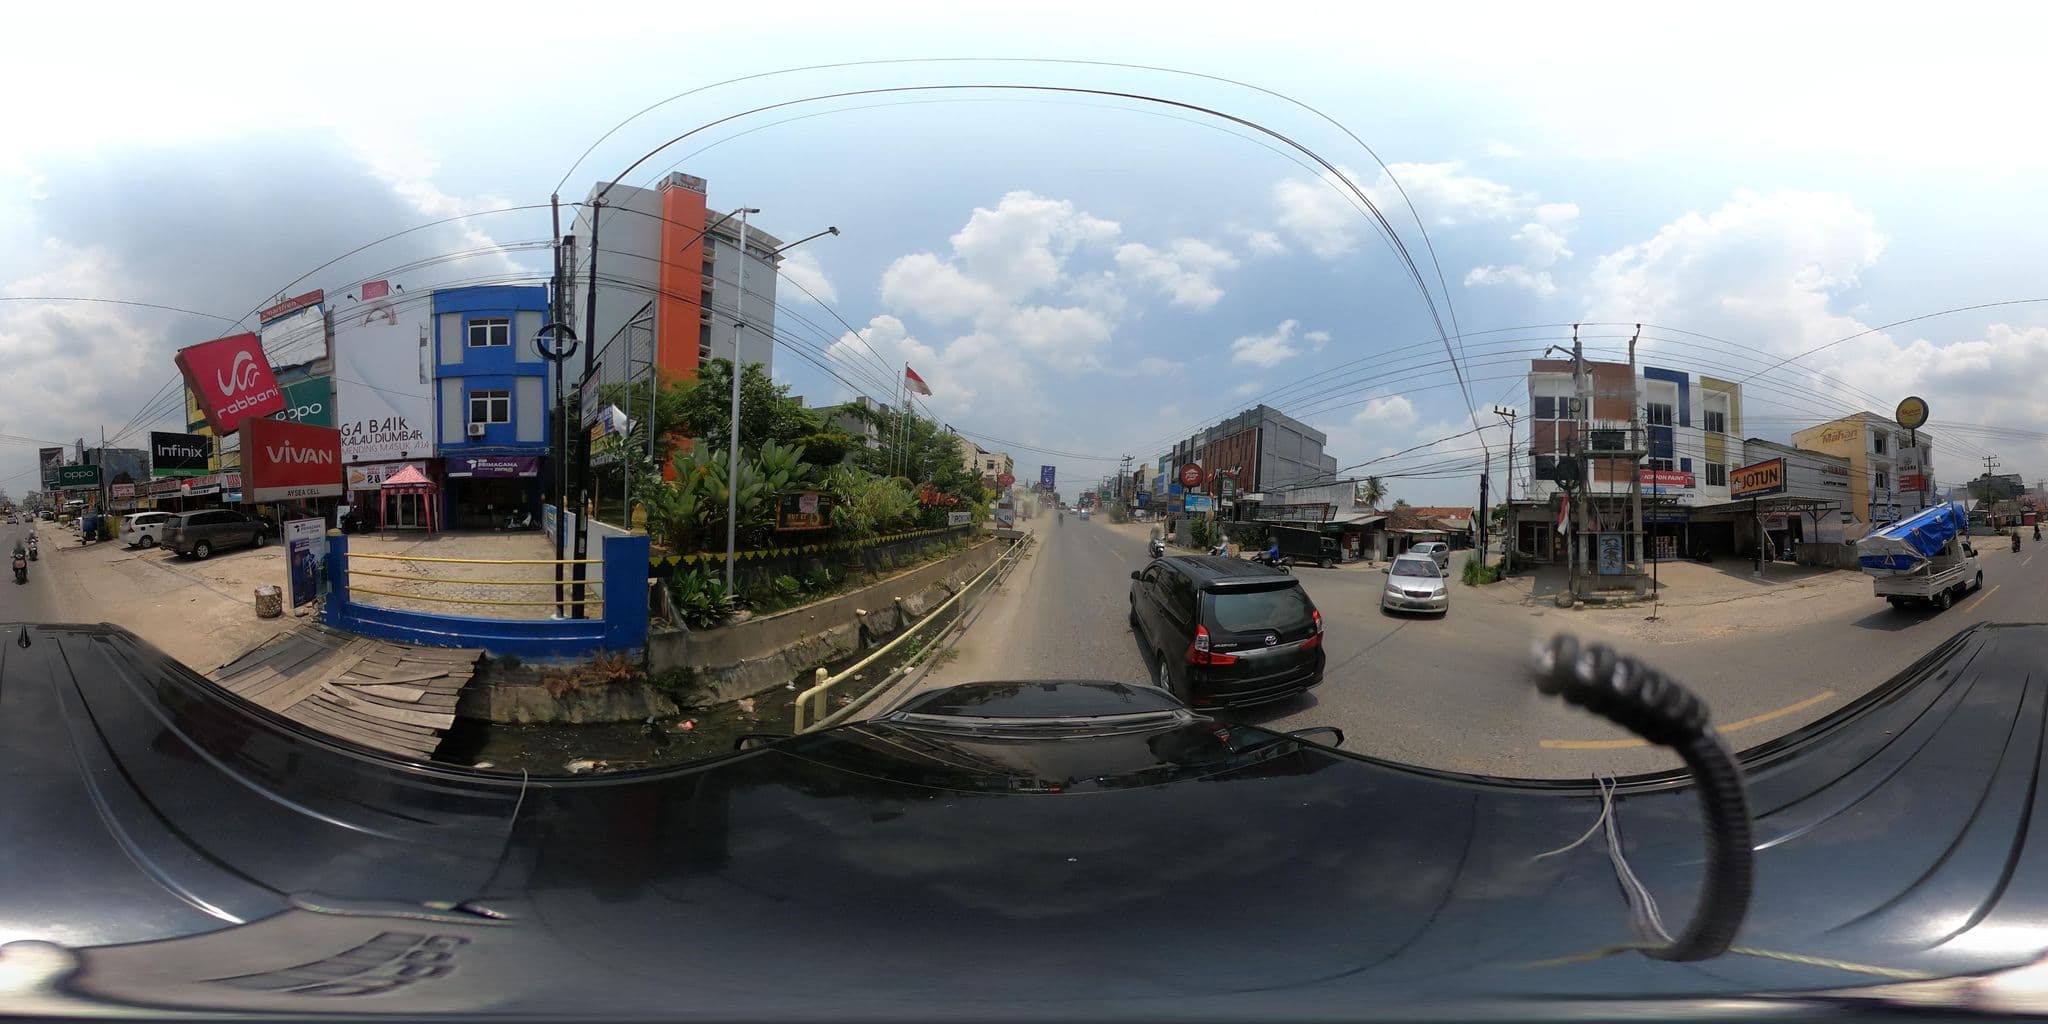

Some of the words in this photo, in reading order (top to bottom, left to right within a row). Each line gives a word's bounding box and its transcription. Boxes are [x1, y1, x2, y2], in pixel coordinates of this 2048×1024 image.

[217, 384, 280, 420] rabbani
[341, 421, 362, 436] GA
[369, 416, 408, 433] BAIK
[341, 434, 373, 447] KALAU
[375, 429, 423, 443] DIUMBAR
[157, 444, 203, 458] Infinix
[379, 442, 410, 452] MASUK
[64, 470, 94, 480] oppo
[1742, 467, 1778, 489] JOTUN
[307, 488, 320, 496] CELL
